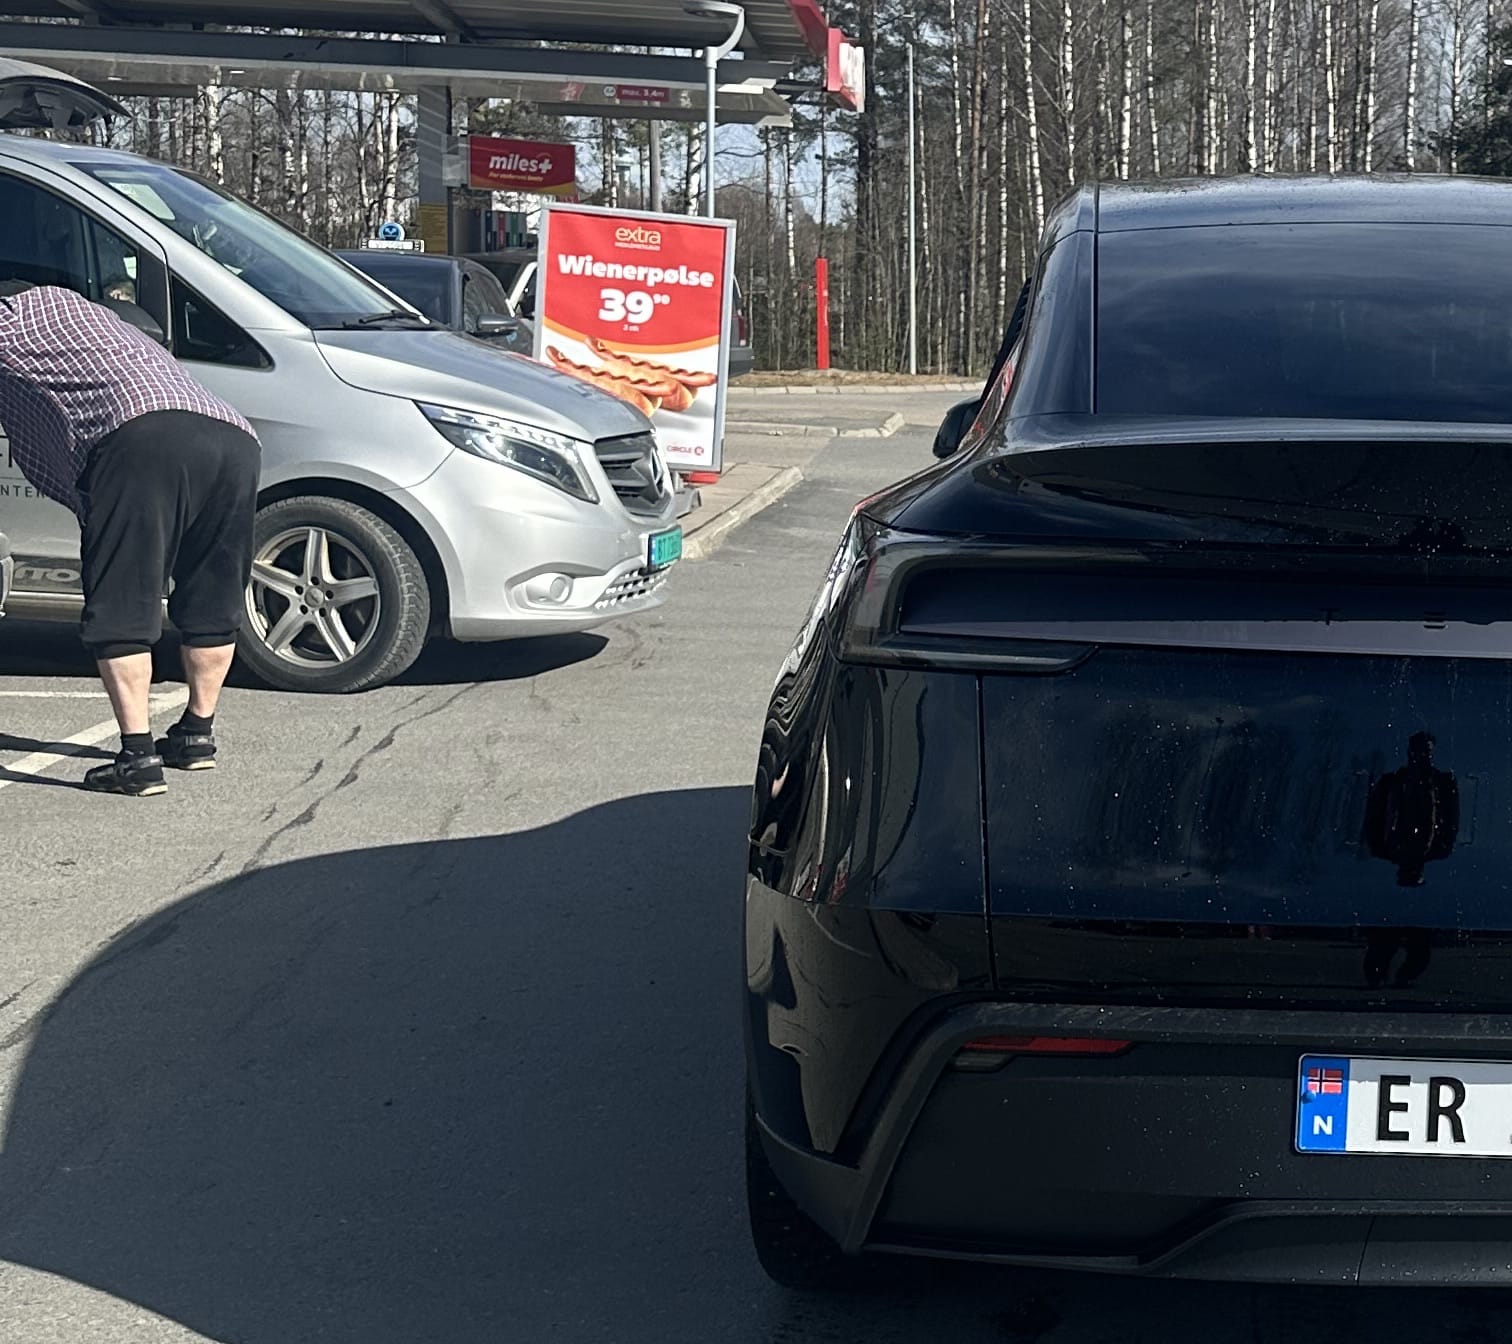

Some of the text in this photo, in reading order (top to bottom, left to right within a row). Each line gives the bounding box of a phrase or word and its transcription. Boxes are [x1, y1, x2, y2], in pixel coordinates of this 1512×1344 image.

[489, 153, 552, 174] miles+
[615, 226, 661, 244] extra
[558, 254, 714, 287] Wienerpølse
[1312, 1116, 1334, 1136] N
[1375, 1074, 1467, 1144] ER
